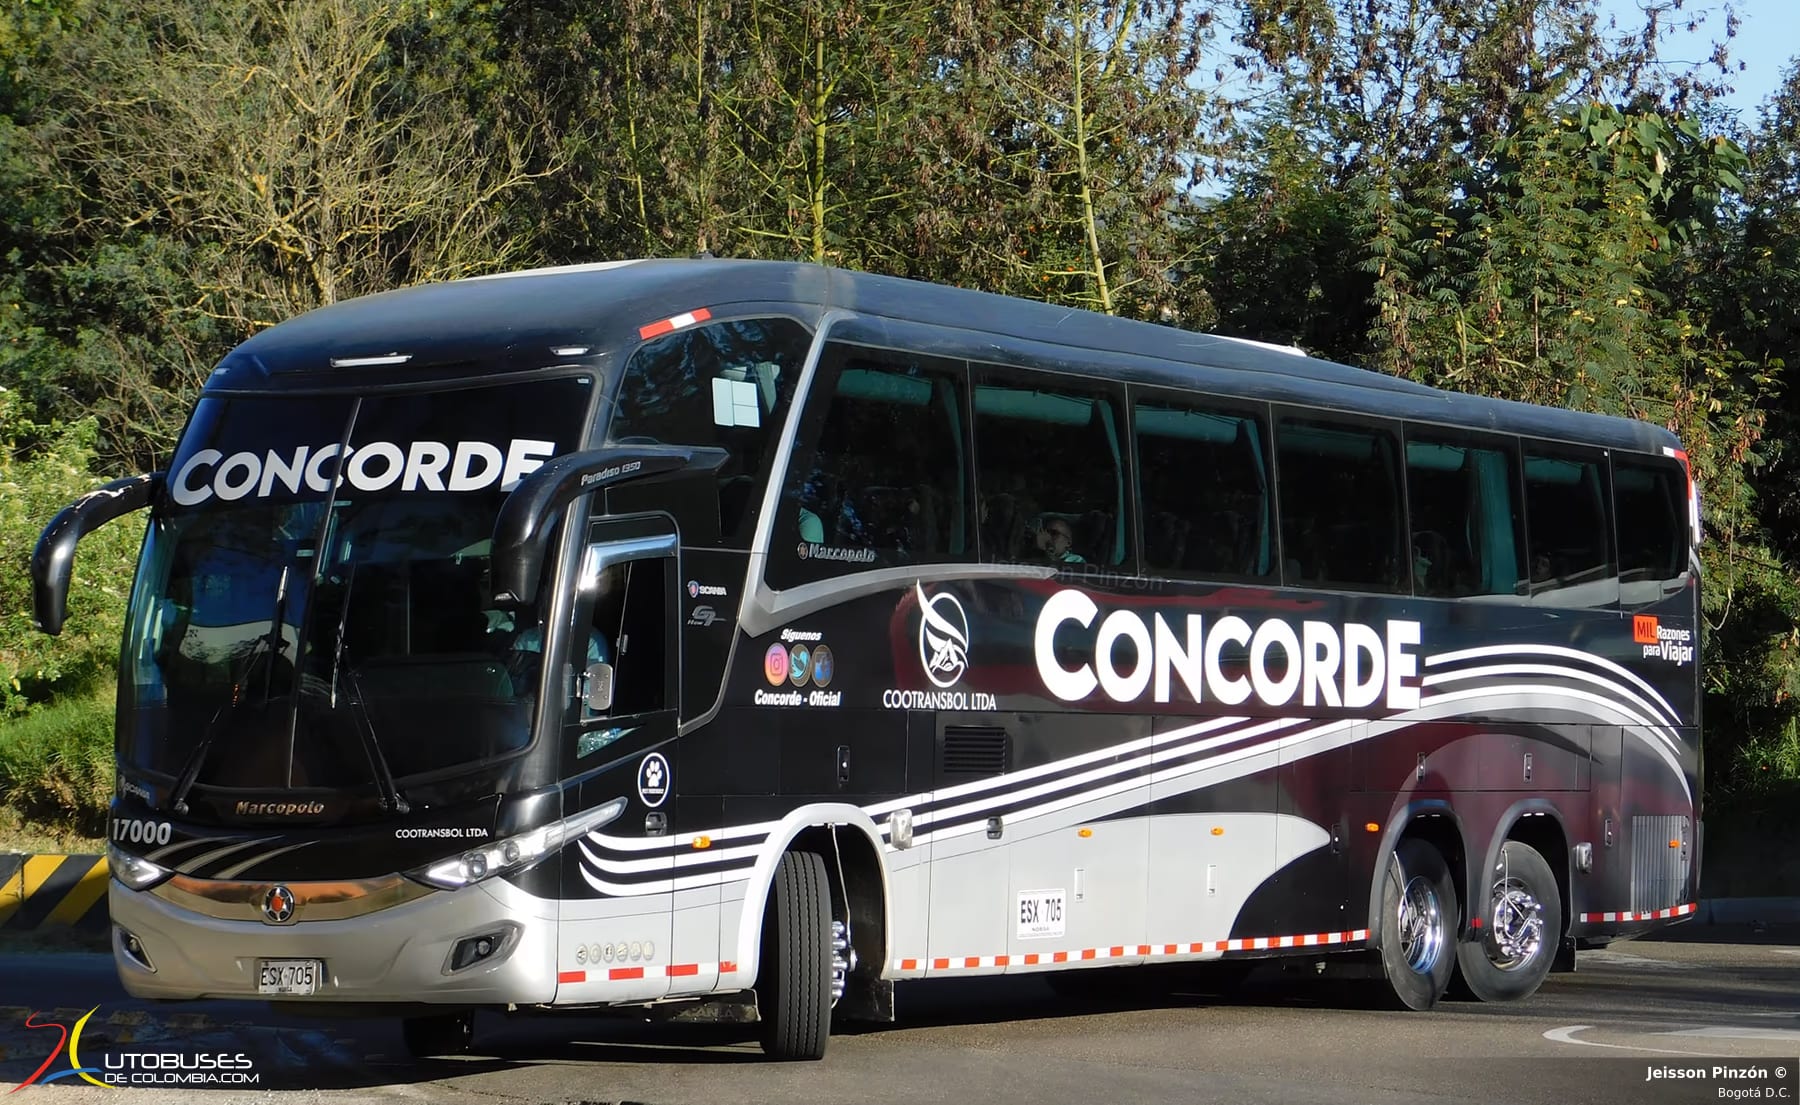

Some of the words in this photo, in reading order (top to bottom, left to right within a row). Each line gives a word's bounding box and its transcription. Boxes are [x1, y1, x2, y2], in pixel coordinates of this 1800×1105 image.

[173, 439, 555, 506] CONCORDE
[581, 467, 620, 487] Paradiso
[621, 461, 641, 473] 1350
[808, 543, 877, 563] Marcopolo
[699, 585, 727, 596] SCANIA
[781, 628, 822, 643] Síguenos
[1637, 621, 1656, 639] MIL
[1656, 625, 1691, 641] Razones
[1034, 589, 1421, 710] CONCORDE
[1643, 645, 1661, 659] para
[1660, 640, 1694, 666] Viajar
[754, 688, 802, 706] Concorde
[809, 690, 841, 707] Oficial
[883, 689, 969, 710] COOTRANSBOL
[970, 692, 997, 711] LTDA
[235, 800, 325, 816] Marcopolo
[112, 818, 172, 846] 17000
[395, 828, 464, 839] COOTRANSBOL
[465, 827, 489, 838] LTDA
[1020, 899, 1040, 924] ESX
[1045, 898, 1062, 922] 705
[261, 967, 285, 986] ESX
[289, 966, 313, 985] 705
